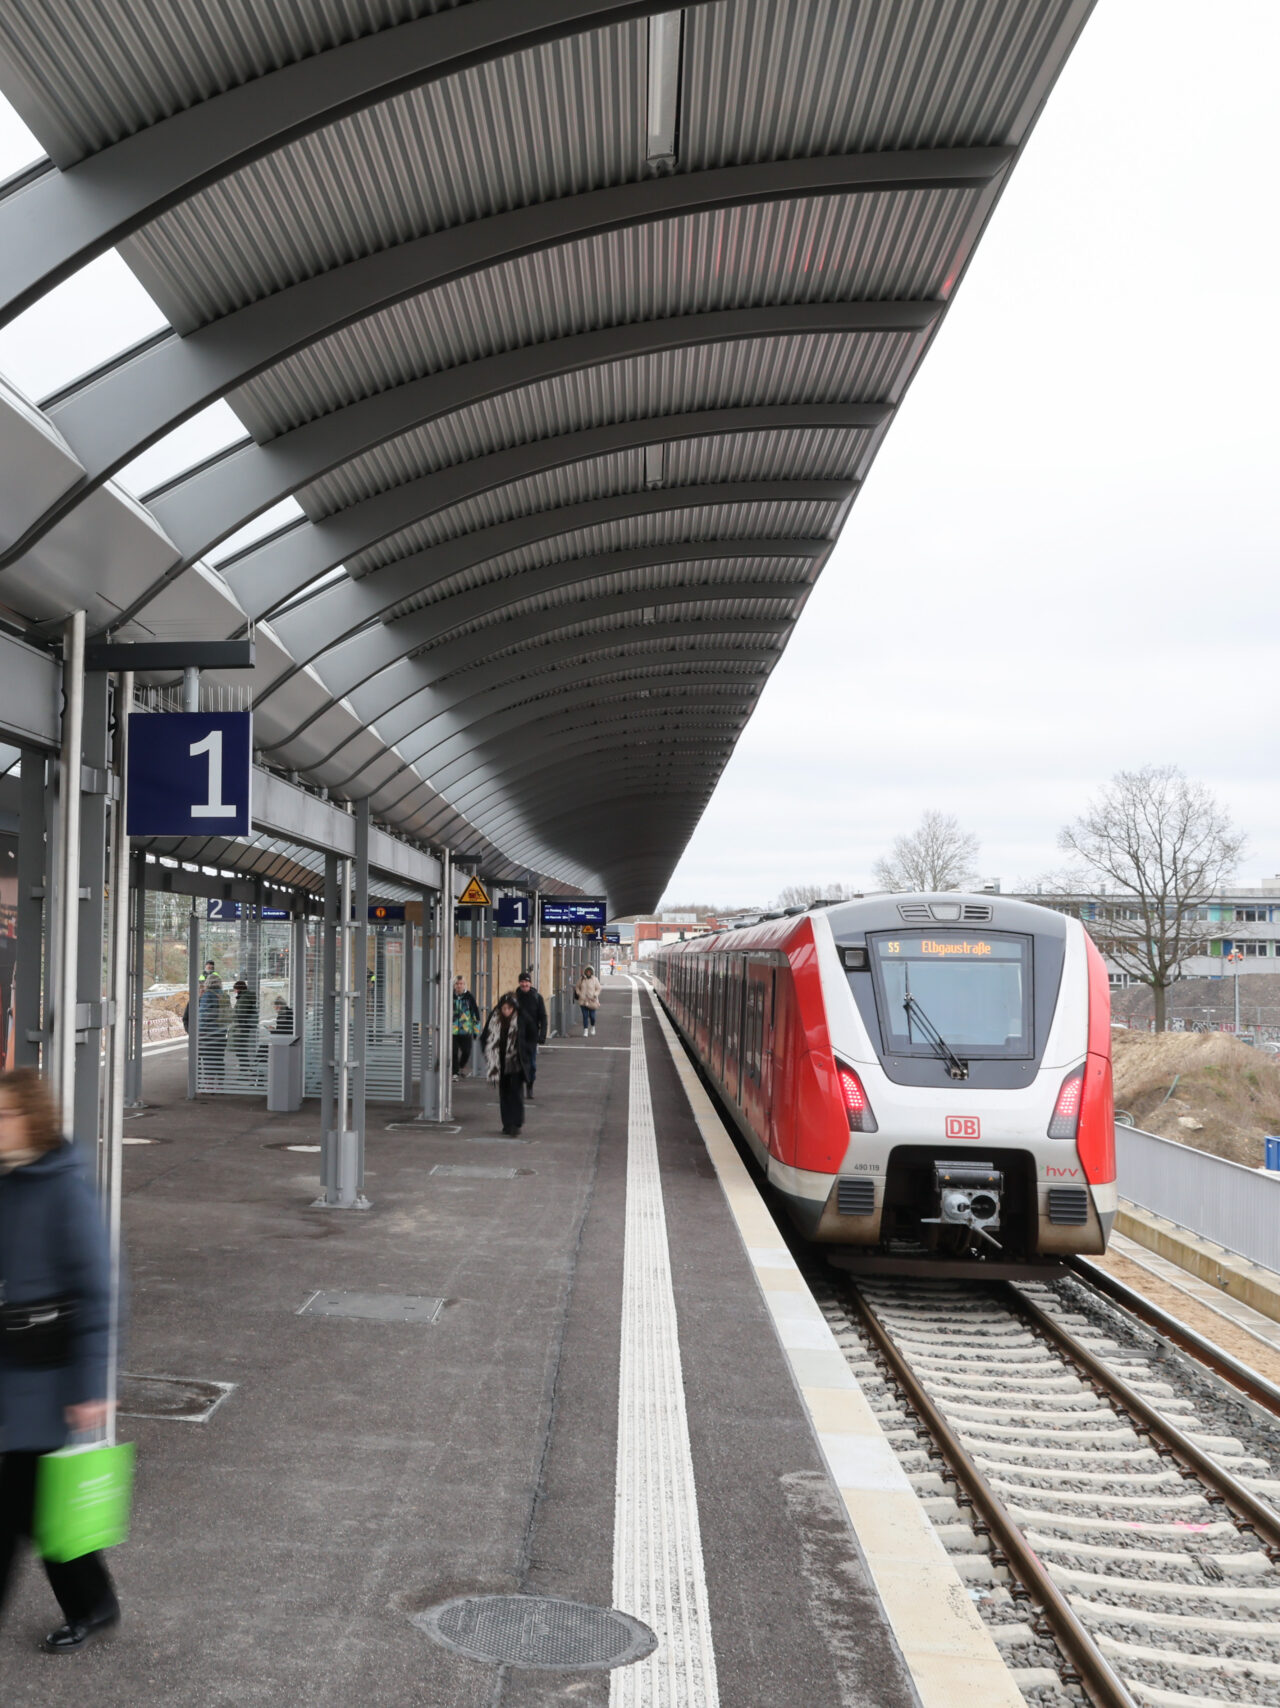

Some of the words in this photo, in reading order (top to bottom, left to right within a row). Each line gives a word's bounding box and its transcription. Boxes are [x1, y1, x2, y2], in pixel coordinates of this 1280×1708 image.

[189, 730, 237, 818] 1
[209, 898, 223, 919] 2
[513, 902, 526, 924] 1
[595, 928, 602, 940] 1
[888, 941, 900, 953] S5
[921, 940, 991, 956] Elbgaustraße
[949, 1119, 977, 1136] DB
[1046, 1165, 1079, 1177] hvv
